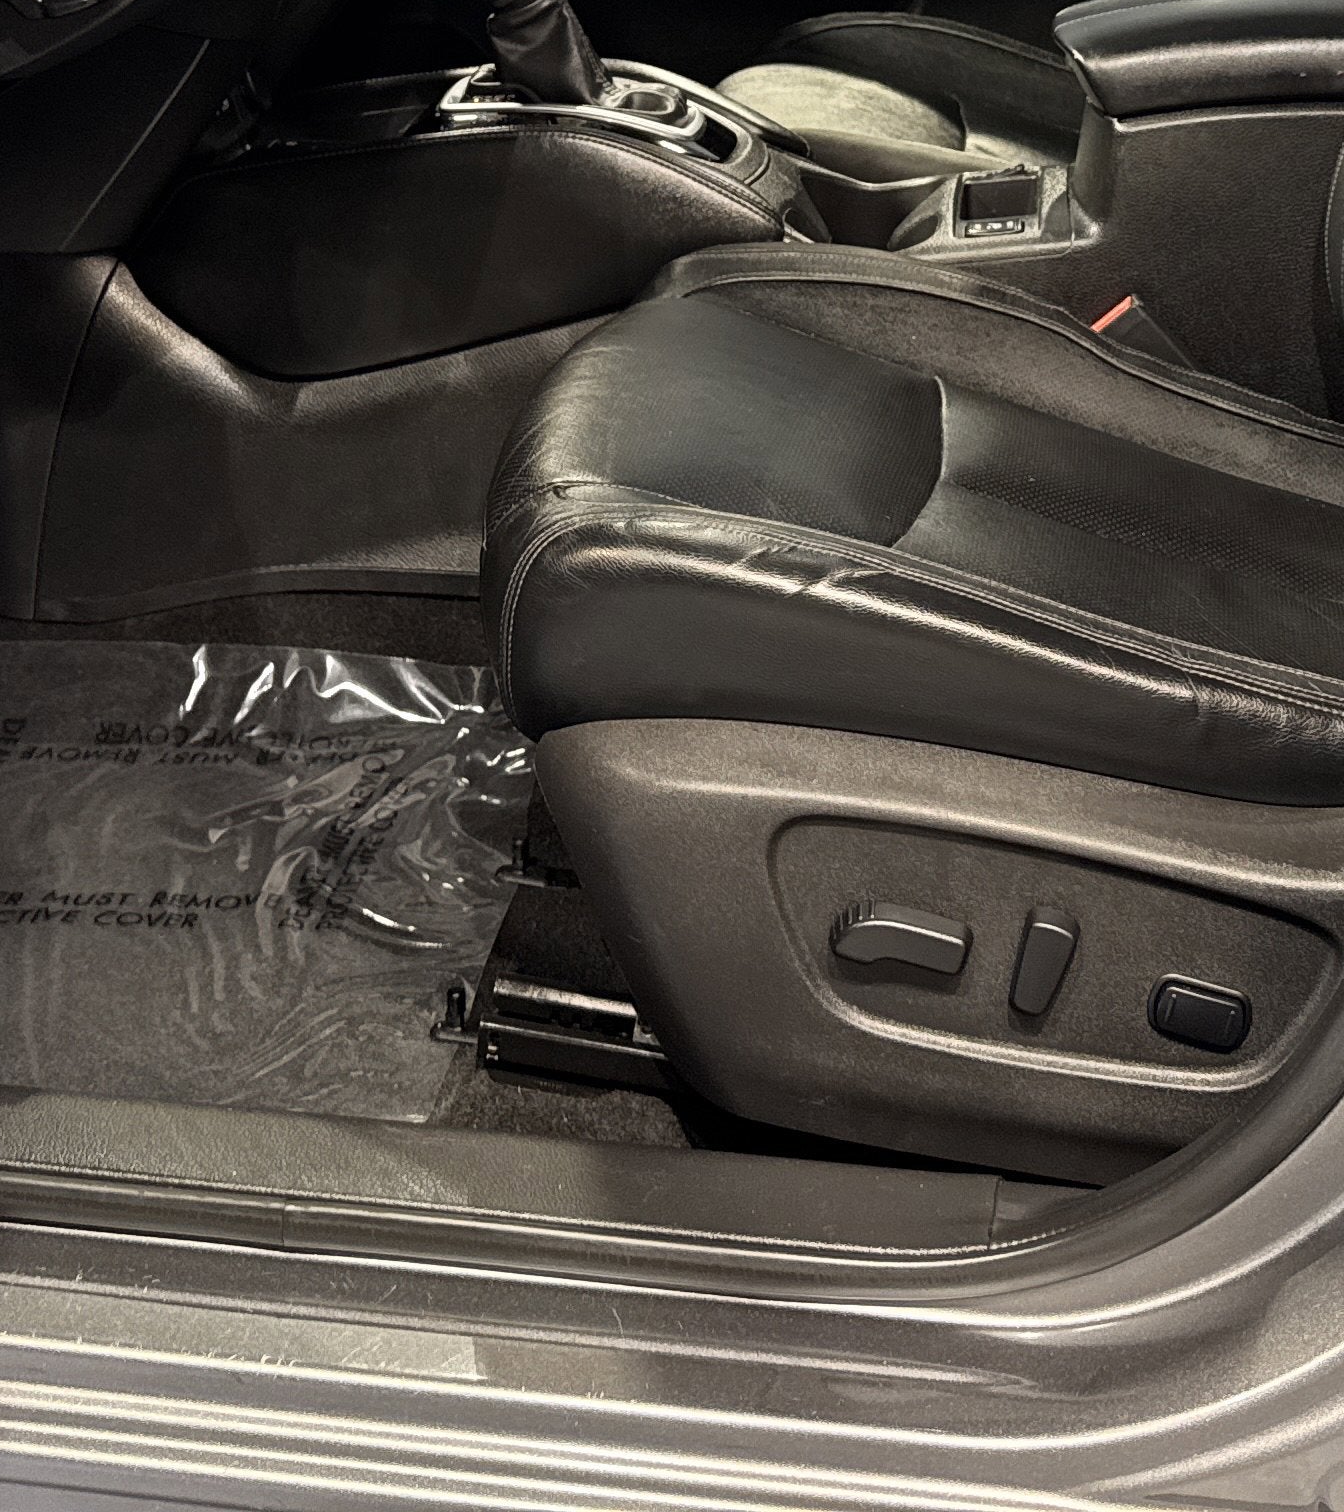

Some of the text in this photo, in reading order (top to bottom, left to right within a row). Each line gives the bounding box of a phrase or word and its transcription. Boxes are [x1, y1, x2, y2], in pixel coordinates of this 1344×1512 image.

[96, 721, 189, 747] COVER
[40, 890, 136, 908] MUST
[93, 909, 199, 929] COVER
